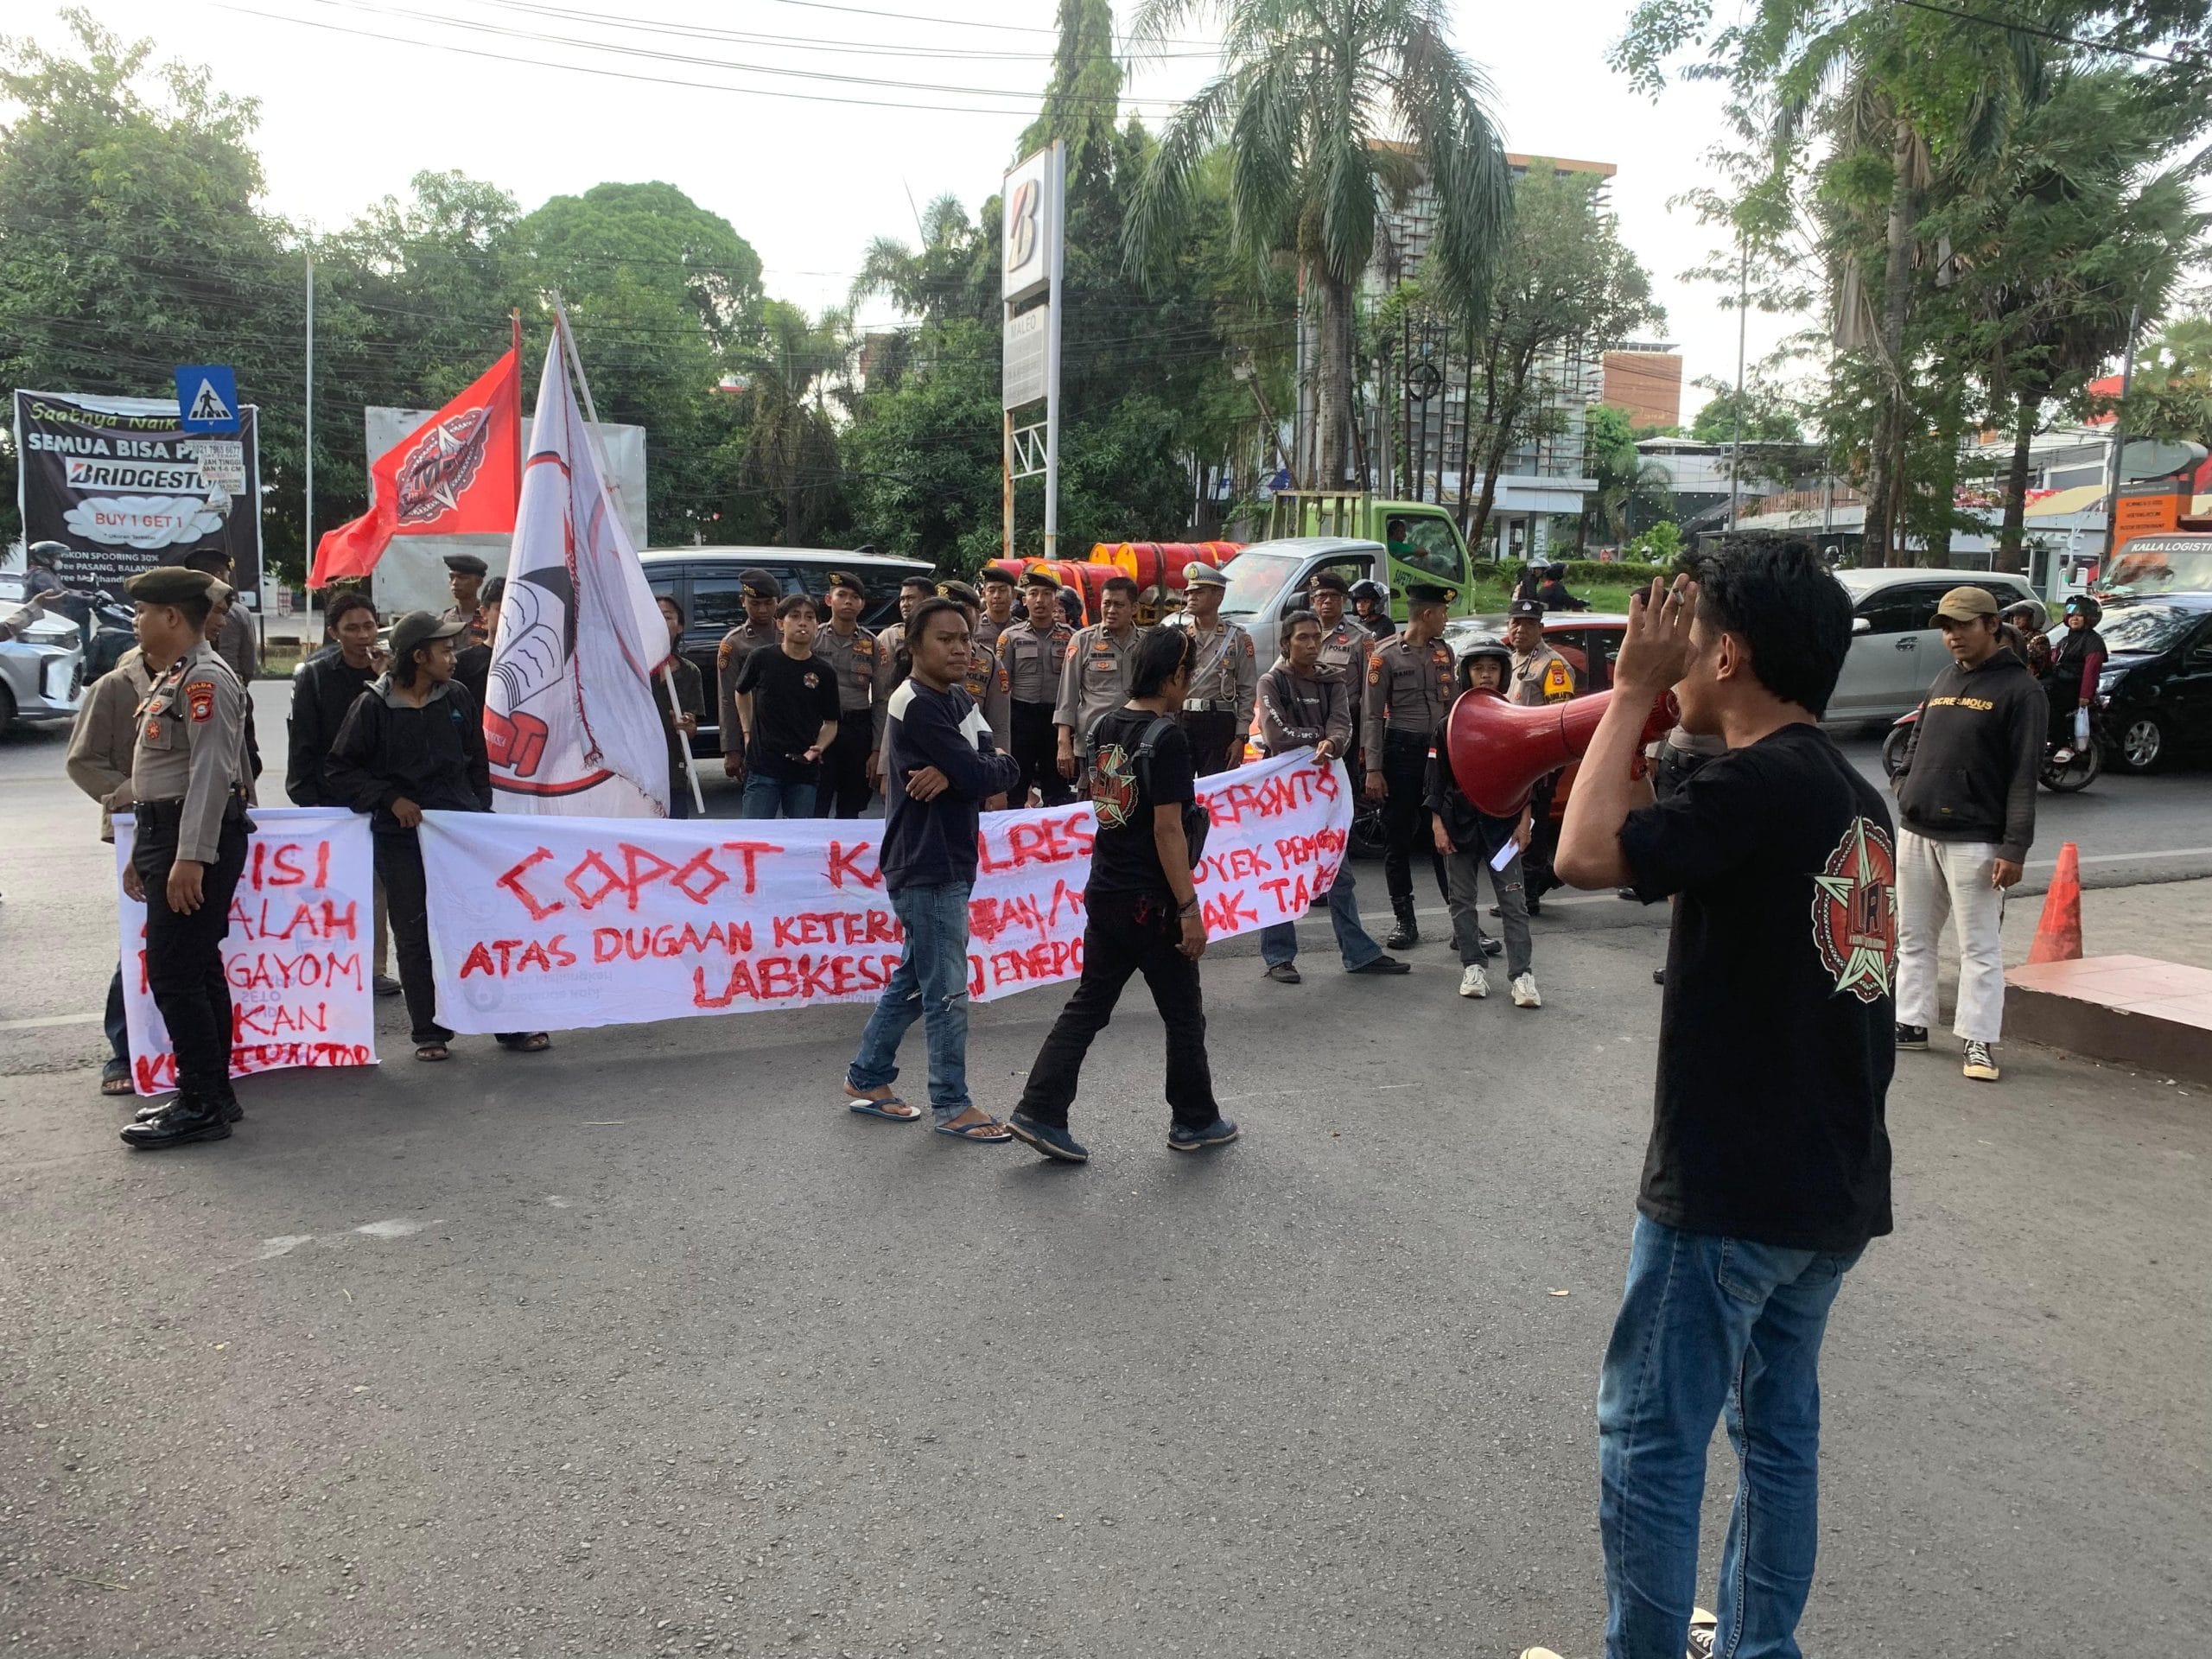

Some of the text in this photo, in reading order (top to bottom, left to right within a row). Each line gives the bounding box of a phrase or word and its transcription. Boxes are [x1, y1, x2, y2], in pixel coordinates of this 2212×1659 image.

[1011, 315, 1036, 340] MALEO
[30, 402, 118, 429] Saatnya
[28, 433, 111, 455] SEMUA
[116, 439, 170, 459] BISA
[70, 462, 216, 490] BRIDGEST
[95, 512, 182, 528] BUY 1 GET 1
[91, 552, 139, 562] SPOORING
[2131, 542, 2212, 552] KALLA LOGISTI
[76, 563, 116, 572] PASANG,
[497, 841, 785, 921] COPOT
[459, 933, 577, 979] ATAS
[592, 920, 753, 964] DUGAAN
